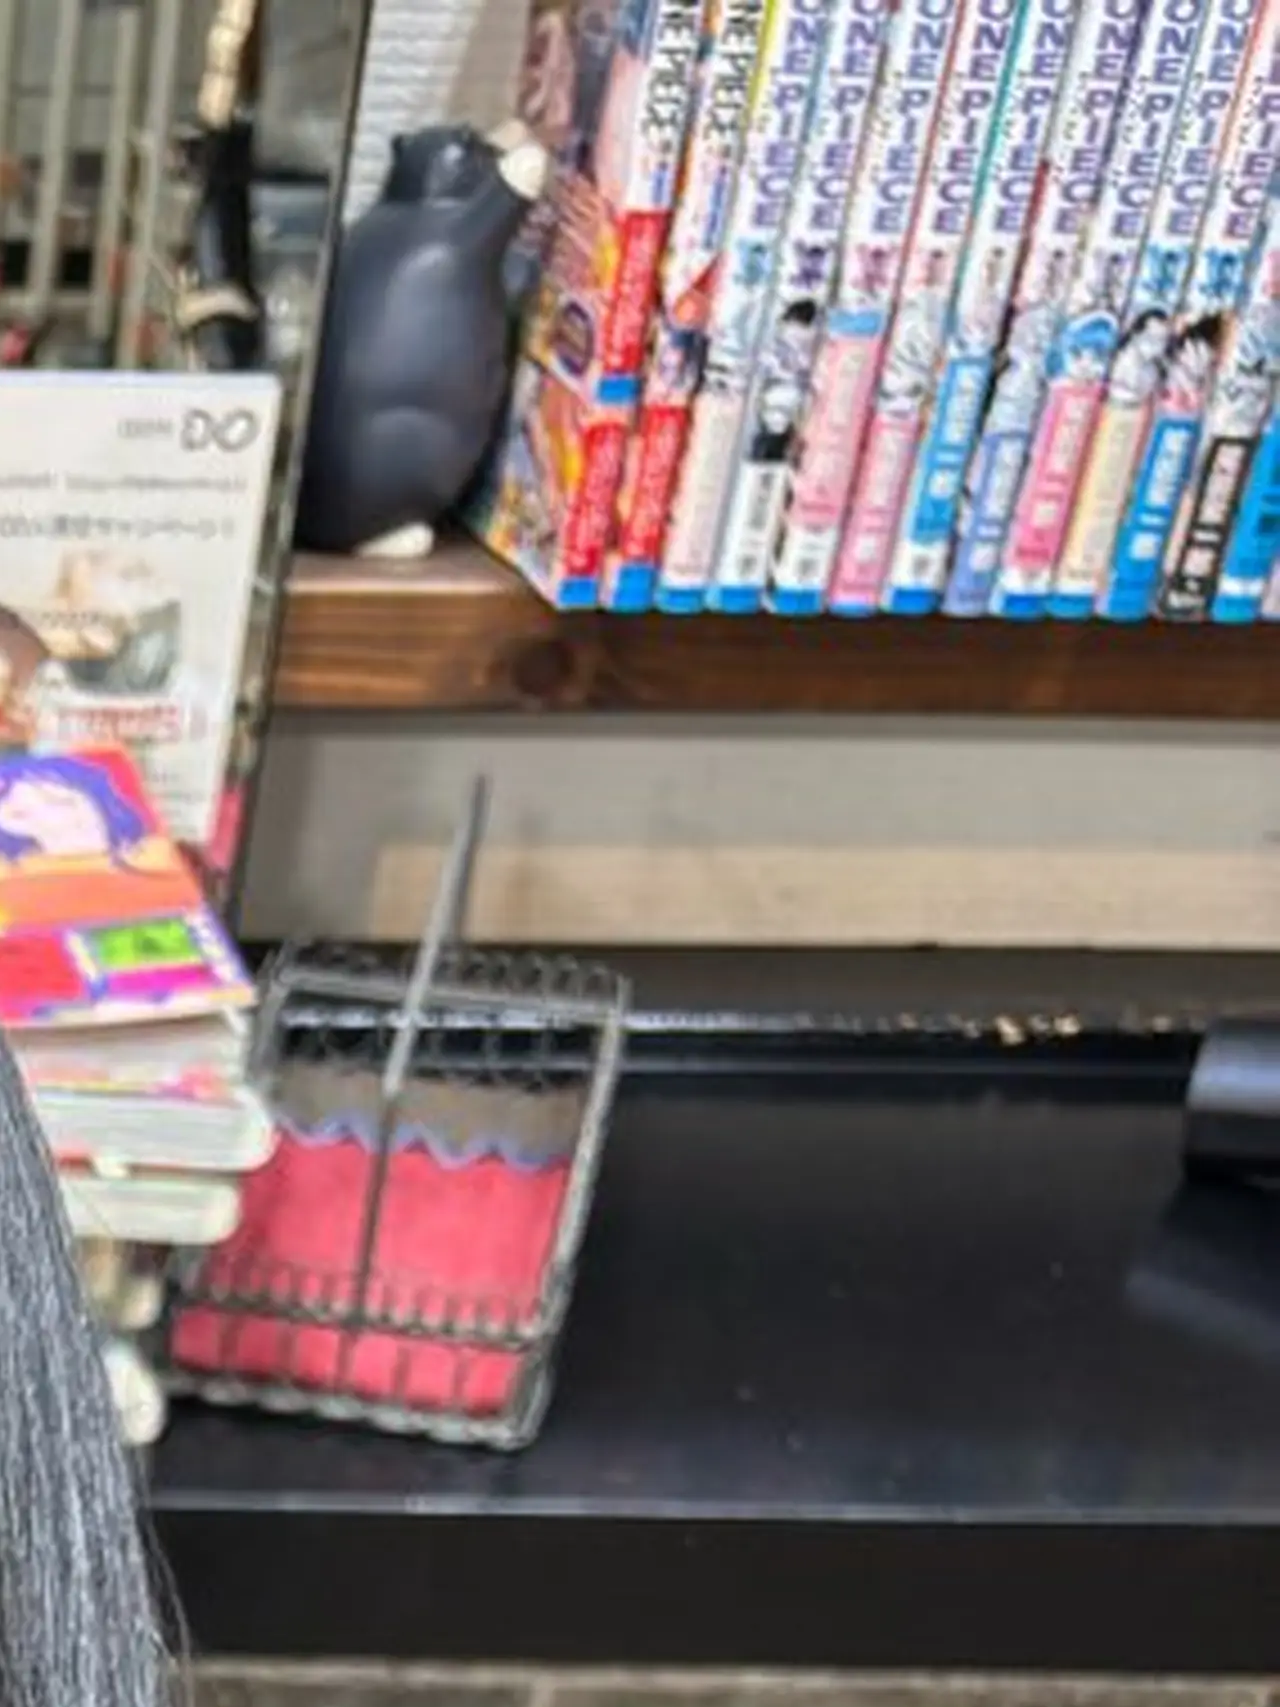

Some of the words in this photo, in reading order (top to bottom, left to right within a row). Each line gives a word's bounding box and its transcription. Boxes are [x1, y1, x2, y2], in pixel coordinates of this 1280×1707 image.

[753, 84, 806, 227] PIECE
[809, 85, 866, 229] PIECE
[871, 89, 930, 233] PIECE
[932, 89, 991, 233] PIECE
[995, 87, 1052, 232] PIECE
[1054, 89, 1115, 233] PIECE
[1111, 92, 1174, 238] PIECE
[1166, 90, 1231, 236] PIECE
